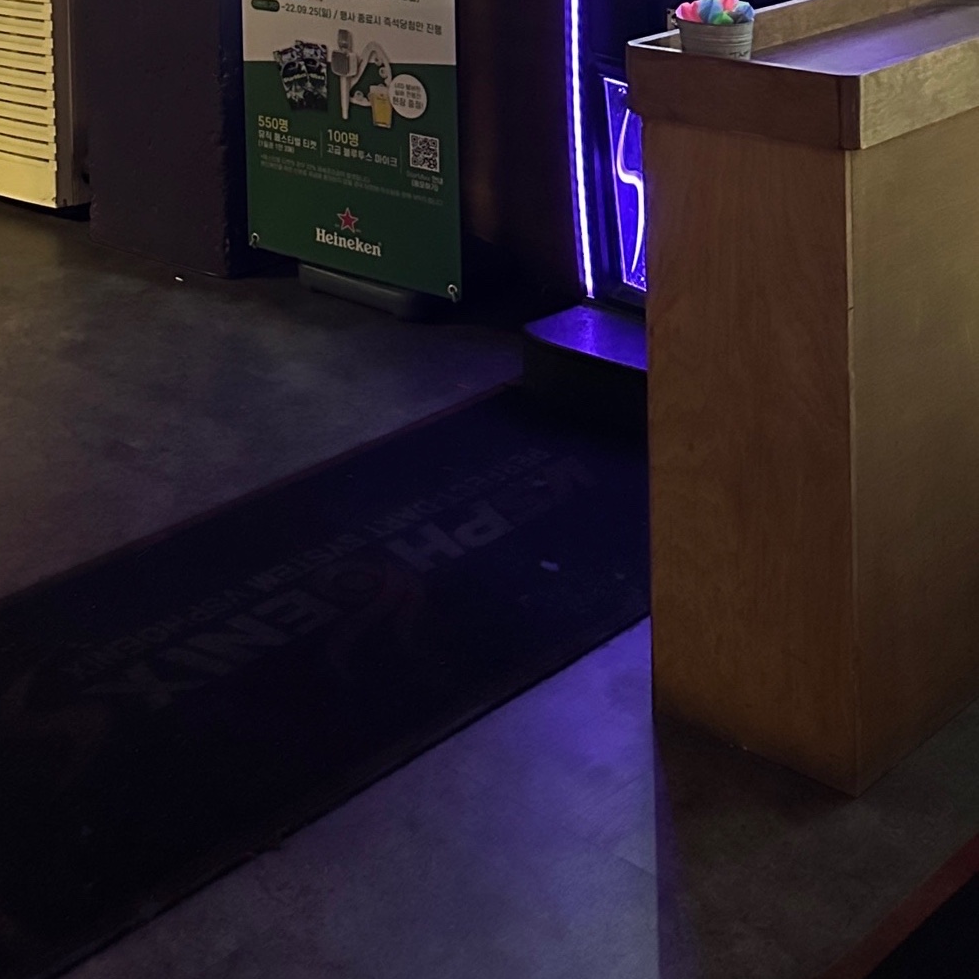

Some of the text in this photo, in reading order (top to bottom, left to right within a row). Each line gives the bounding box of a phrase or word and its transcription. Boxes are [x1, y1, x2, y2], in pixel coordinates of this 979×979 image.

[257, 114, 289, 133] 550명
[273, 132, 302, 147] 페스티벌
[302, 137, 318, 151] 티켓
[327, 128, 360, 147] 100명
[327, 143, 399, 168] 고급 블루투스 마이크
[315, 226, 382, 257] Heineken
